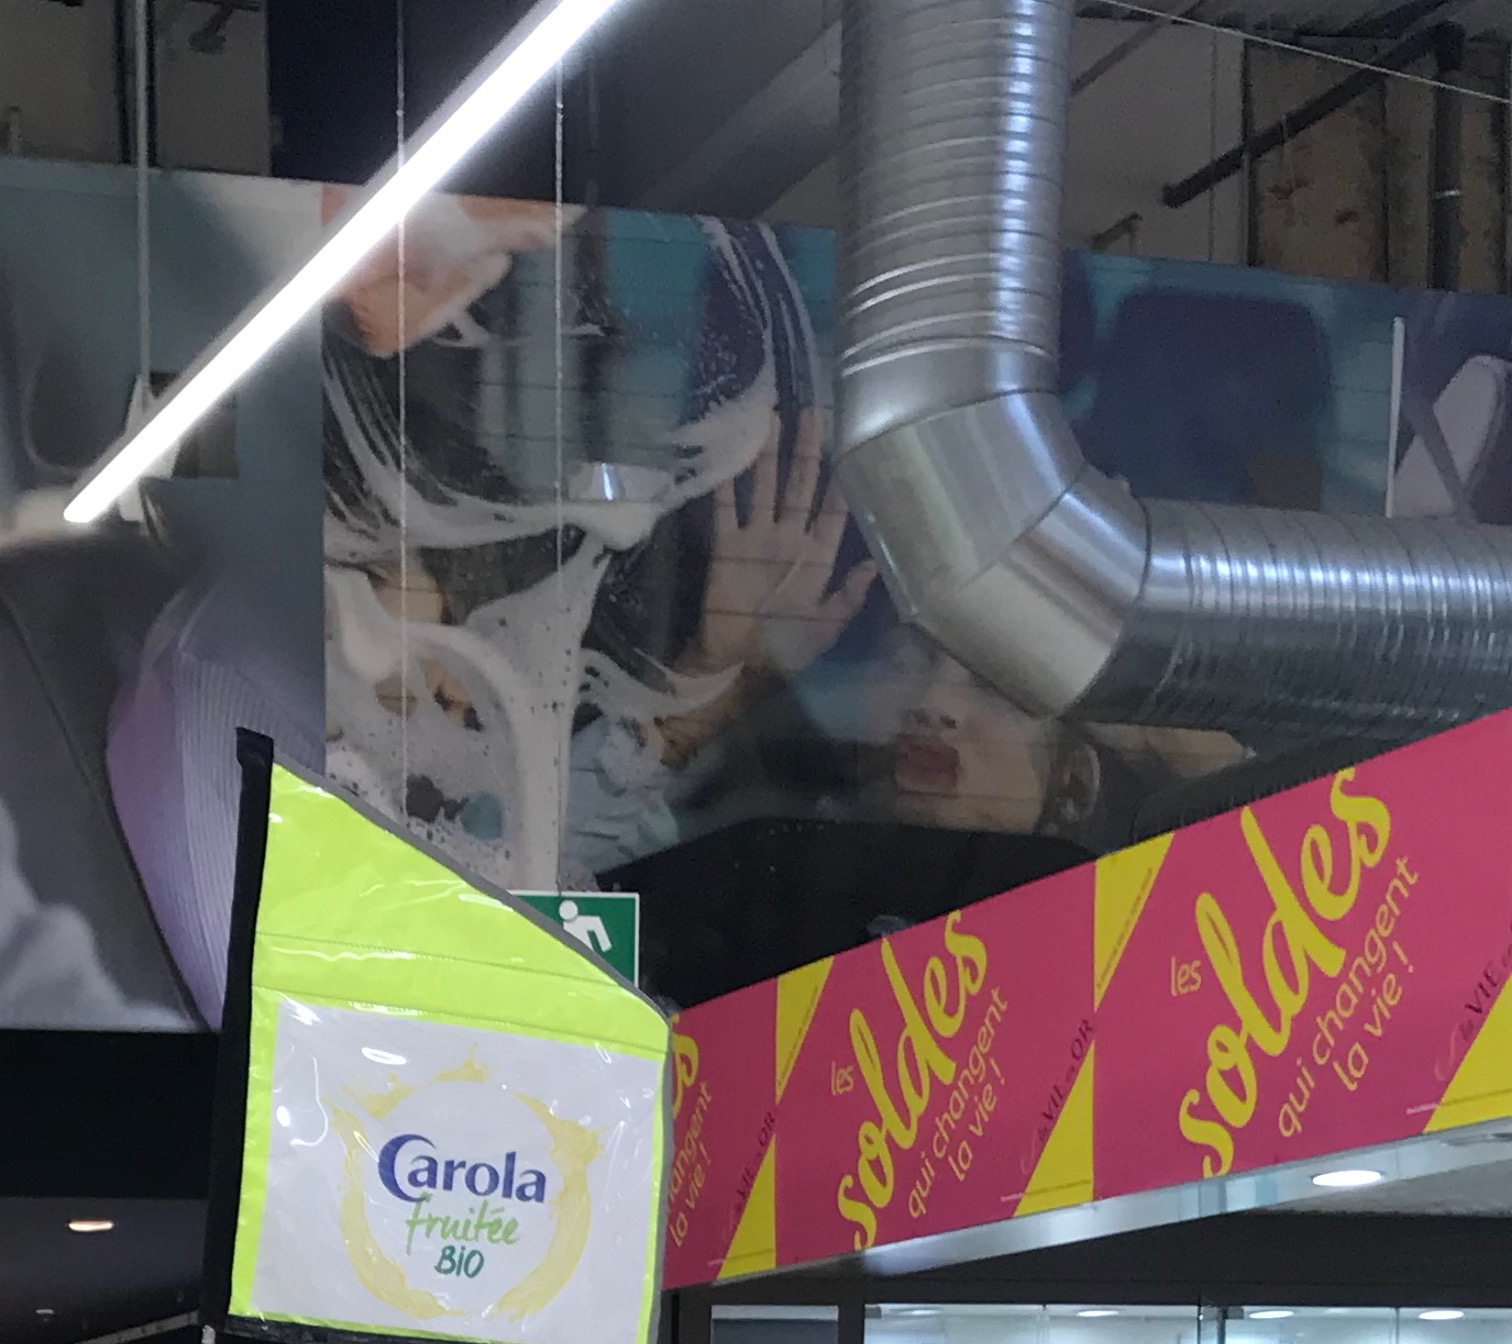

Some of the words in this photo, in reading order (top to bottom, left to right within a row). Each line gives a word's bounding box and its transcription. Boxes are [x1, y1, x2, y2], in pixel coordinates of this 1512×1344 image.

[1170, 956, 1202, 997] les
[1179, 766, 1391, 1179] soldes
[1278, 1057, 1316, 1138] qui
[1312, 855, 1420, 1066] changent
[831, 1060, 855, 1096] les
[838, 909, 988, 1251] soldes
[1333, 1041, 1369, 1091] la
[1364, 972, 1403, 1037] vie
[669, 1079, 712, 1202] angent
[908, 1151, 936, 1219] qui
[932, 985, 1009, 1160] changent
[947, 1143, 974, 1182] la
[969, 1083, 998, 1137] vie
[377, 1133, 547, 1204] Carola
[669, 1217, 689, 1248] la
[684, 1163, 706, 1211] vie
[405, 1190, 520, 1257] fruitée
